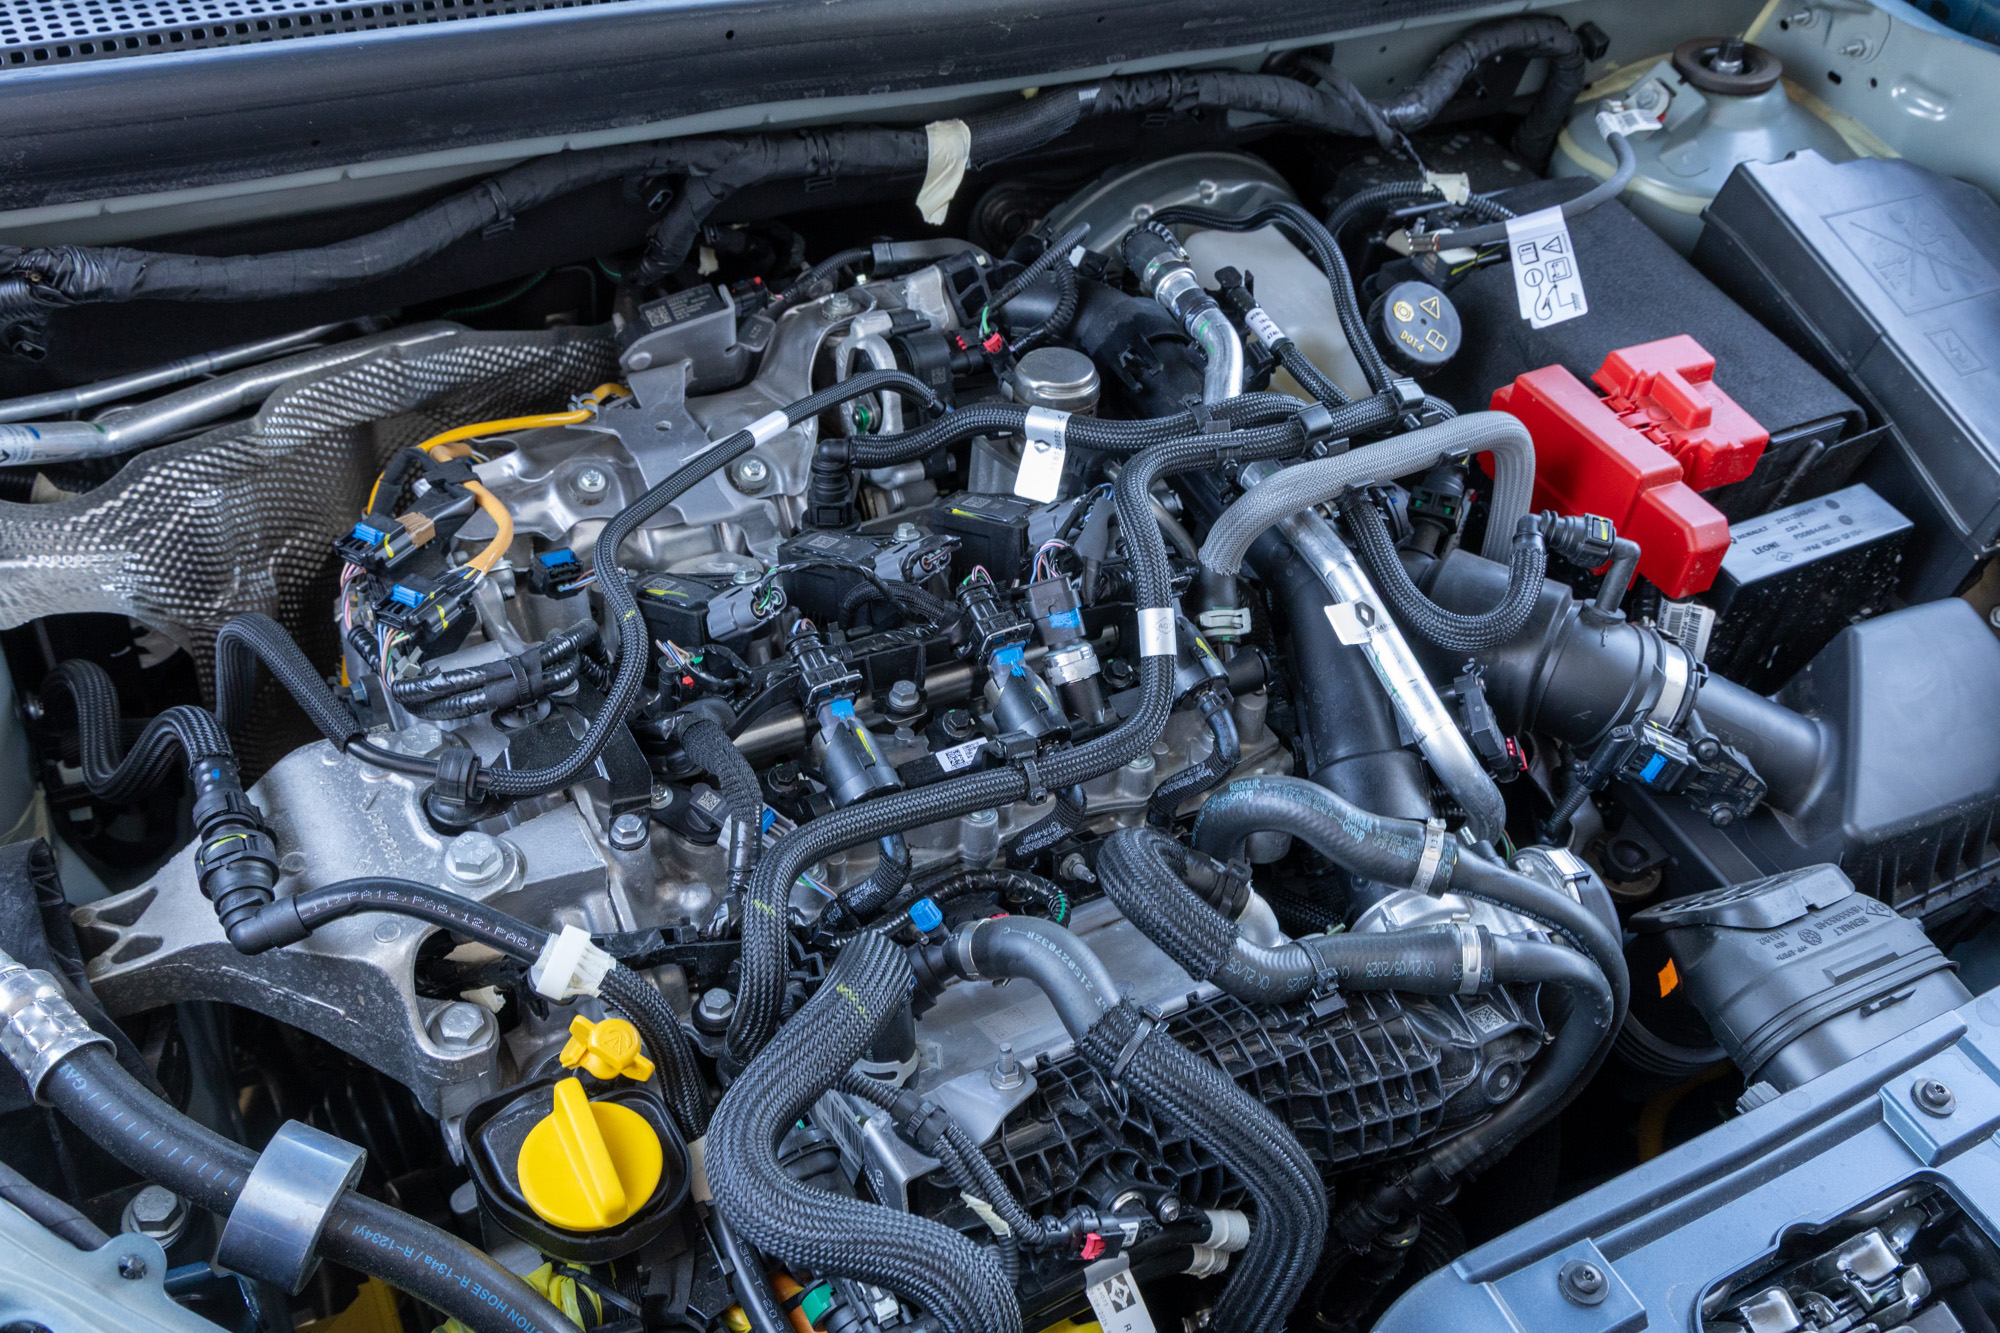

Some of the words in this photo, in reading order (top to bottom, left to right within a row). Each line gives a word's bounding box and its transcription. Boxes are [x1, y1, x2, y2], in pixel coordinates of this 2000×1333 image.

[1399, 329, 1420, 348] DOT
[1416, 343, 1426, 354] 4
[1736, 525, 1768, 539] RENAULT
[1751, 540, 1780, 555] LEONI
[1229, 779, 1259, 791] Renault
[1230, 791, 1253, 801] Group
[1341, 820, 1365, 844] Group
[1832, 915, 1869, 936] RENAULT
[350, 1222, 413, 1257] R-1234yf
[421, 1251, 471, 1288] R-134a
[469, 1281, 509, 1313] HOSE
[1123, 1322, 1132, 1332] R
